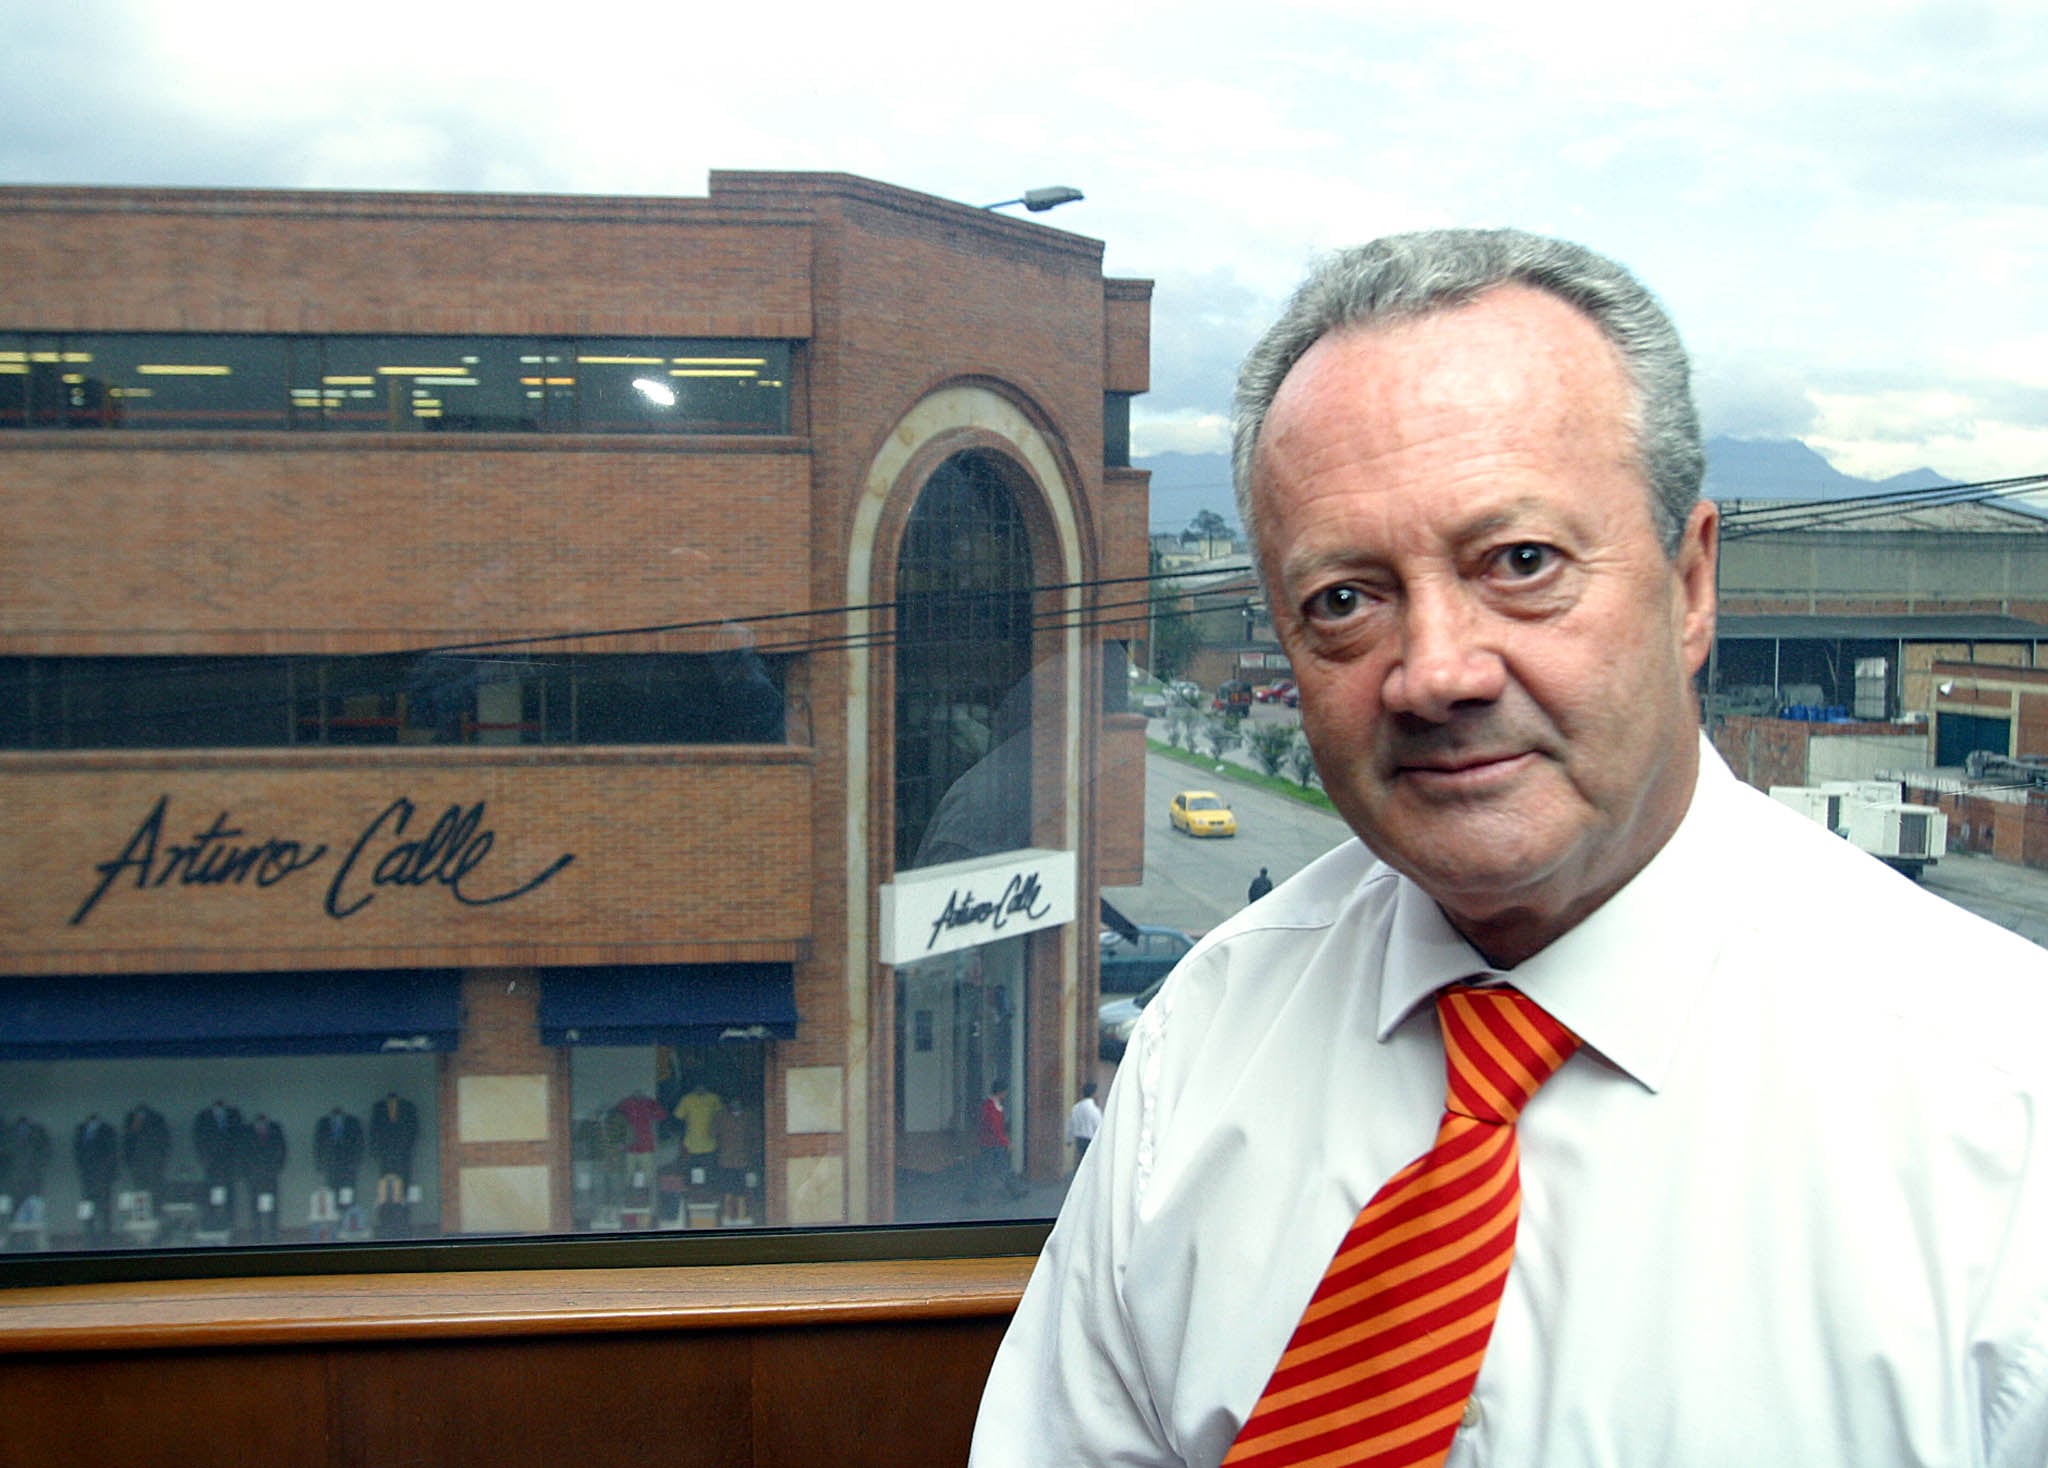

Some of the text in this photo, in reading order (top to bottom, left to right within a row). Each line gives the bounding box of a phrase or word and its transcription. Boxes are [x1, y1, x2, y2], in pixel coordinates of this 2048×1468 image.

[69, 794, 576, 926] Arturo Calle
[927, 871, 1051, 949] Arturo Calle
